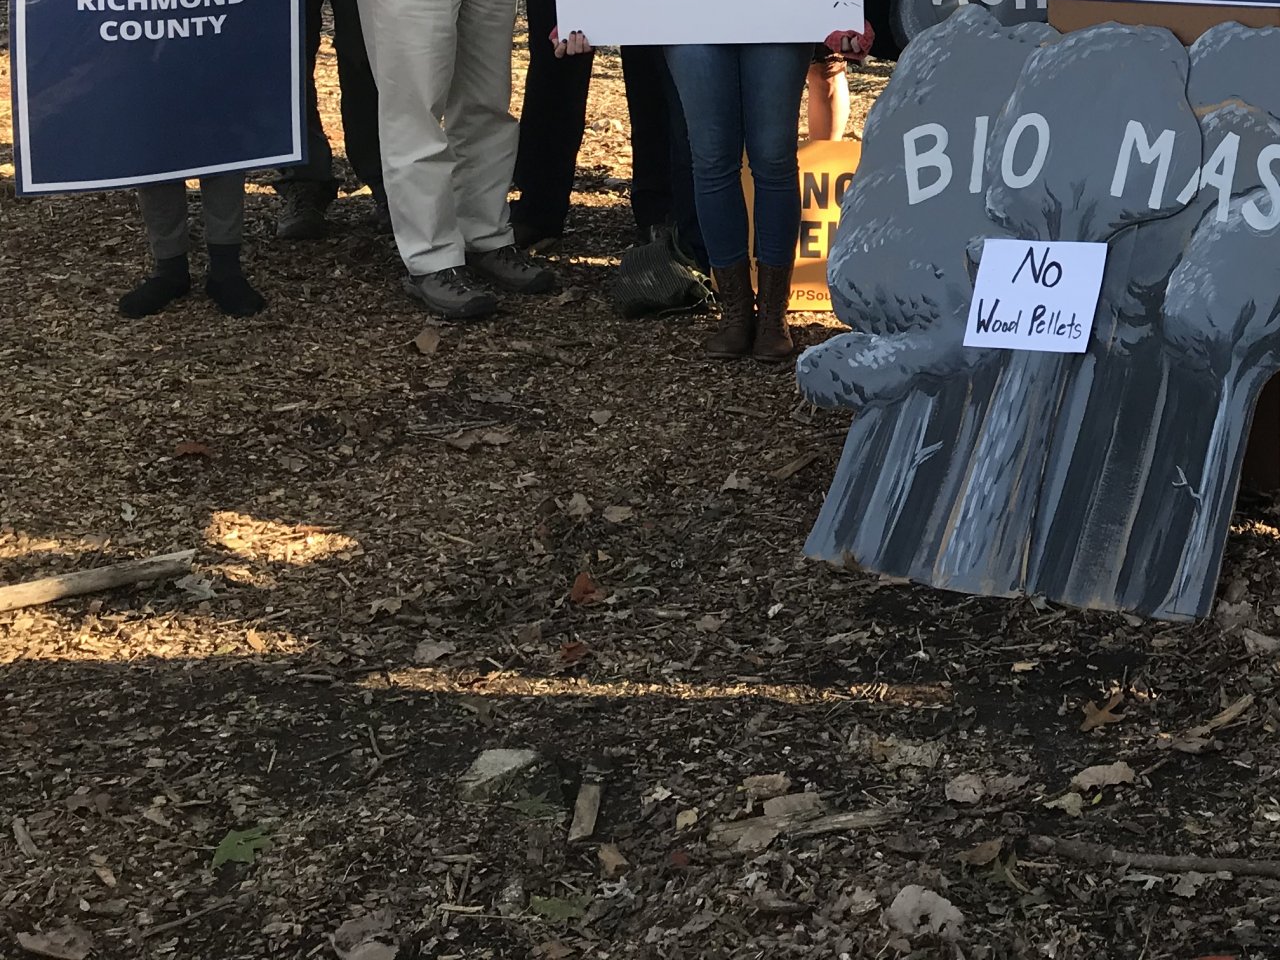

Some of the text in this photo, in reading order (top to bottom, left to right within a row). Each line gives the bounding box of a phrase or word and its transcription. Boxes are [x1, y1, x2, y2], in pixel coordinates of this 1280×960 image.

[99, 14, 227, 41] COUNTY
[903, 112, 1051, 205] BIO
[1011, 246, 1063, 288] No
[976, 298, 1082, 340] Wood Pellets
